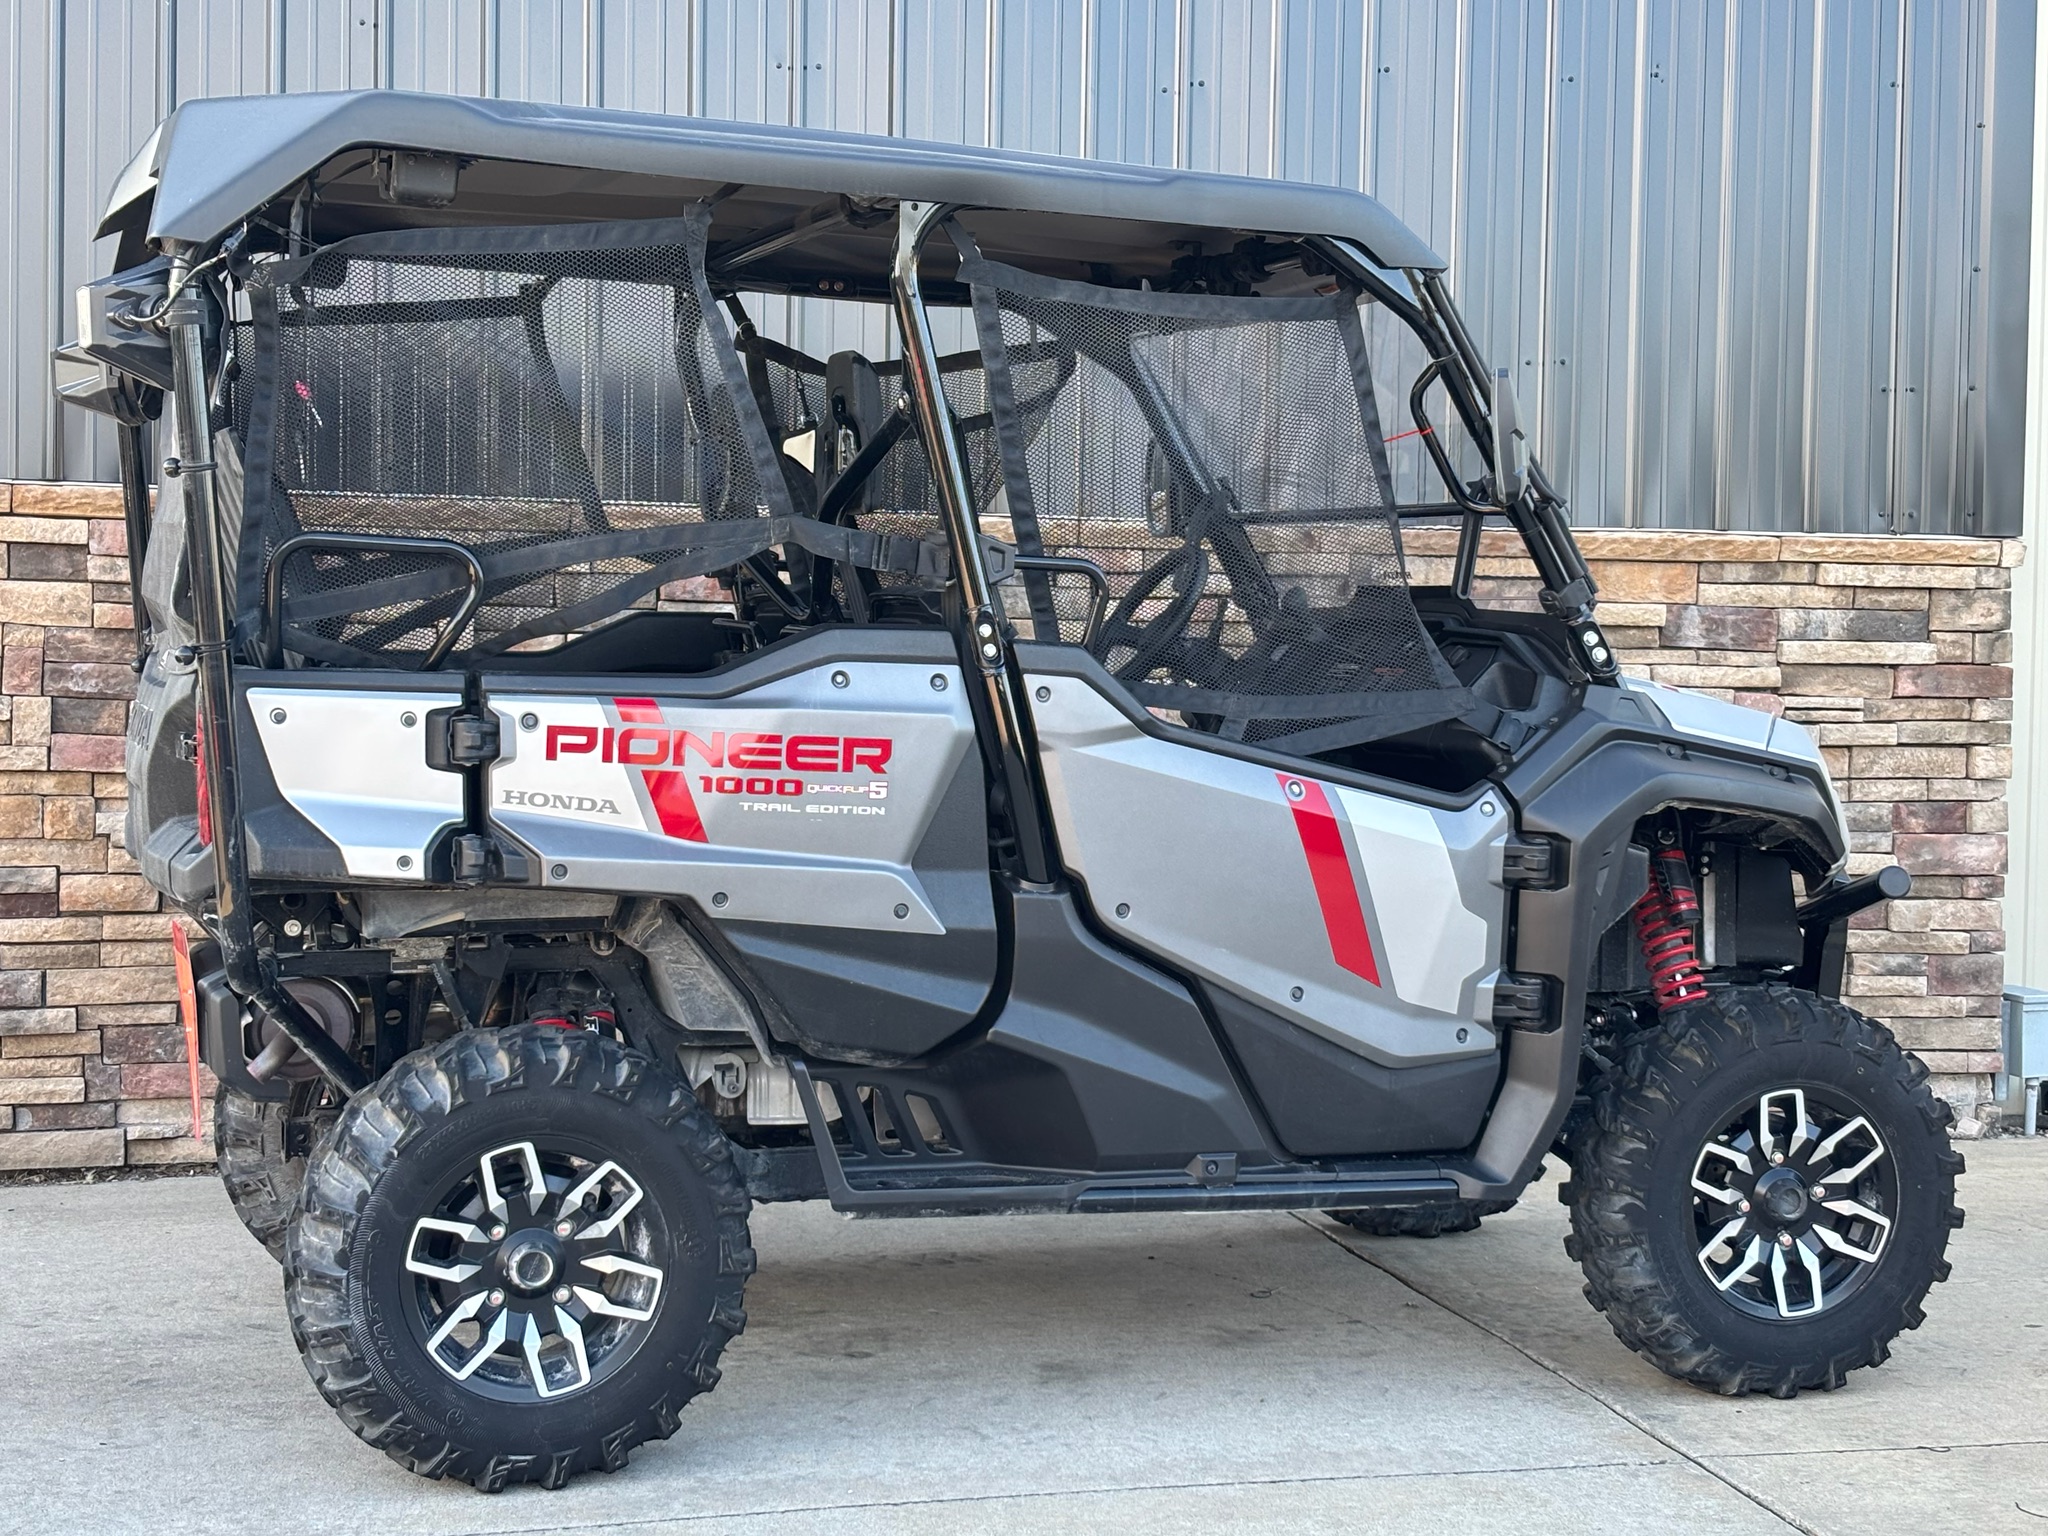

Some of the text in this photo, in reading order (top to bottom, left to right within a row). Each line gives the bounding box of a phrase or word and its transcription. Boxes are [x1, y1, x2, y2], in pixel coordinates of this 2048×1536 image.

[545, 725, 892, 775] PIONEER
[699, 775, 804, 797] 1000
[501, 789, 622, 815] HONDA
[738, 801, 886, 816] TRAIL EDITION
